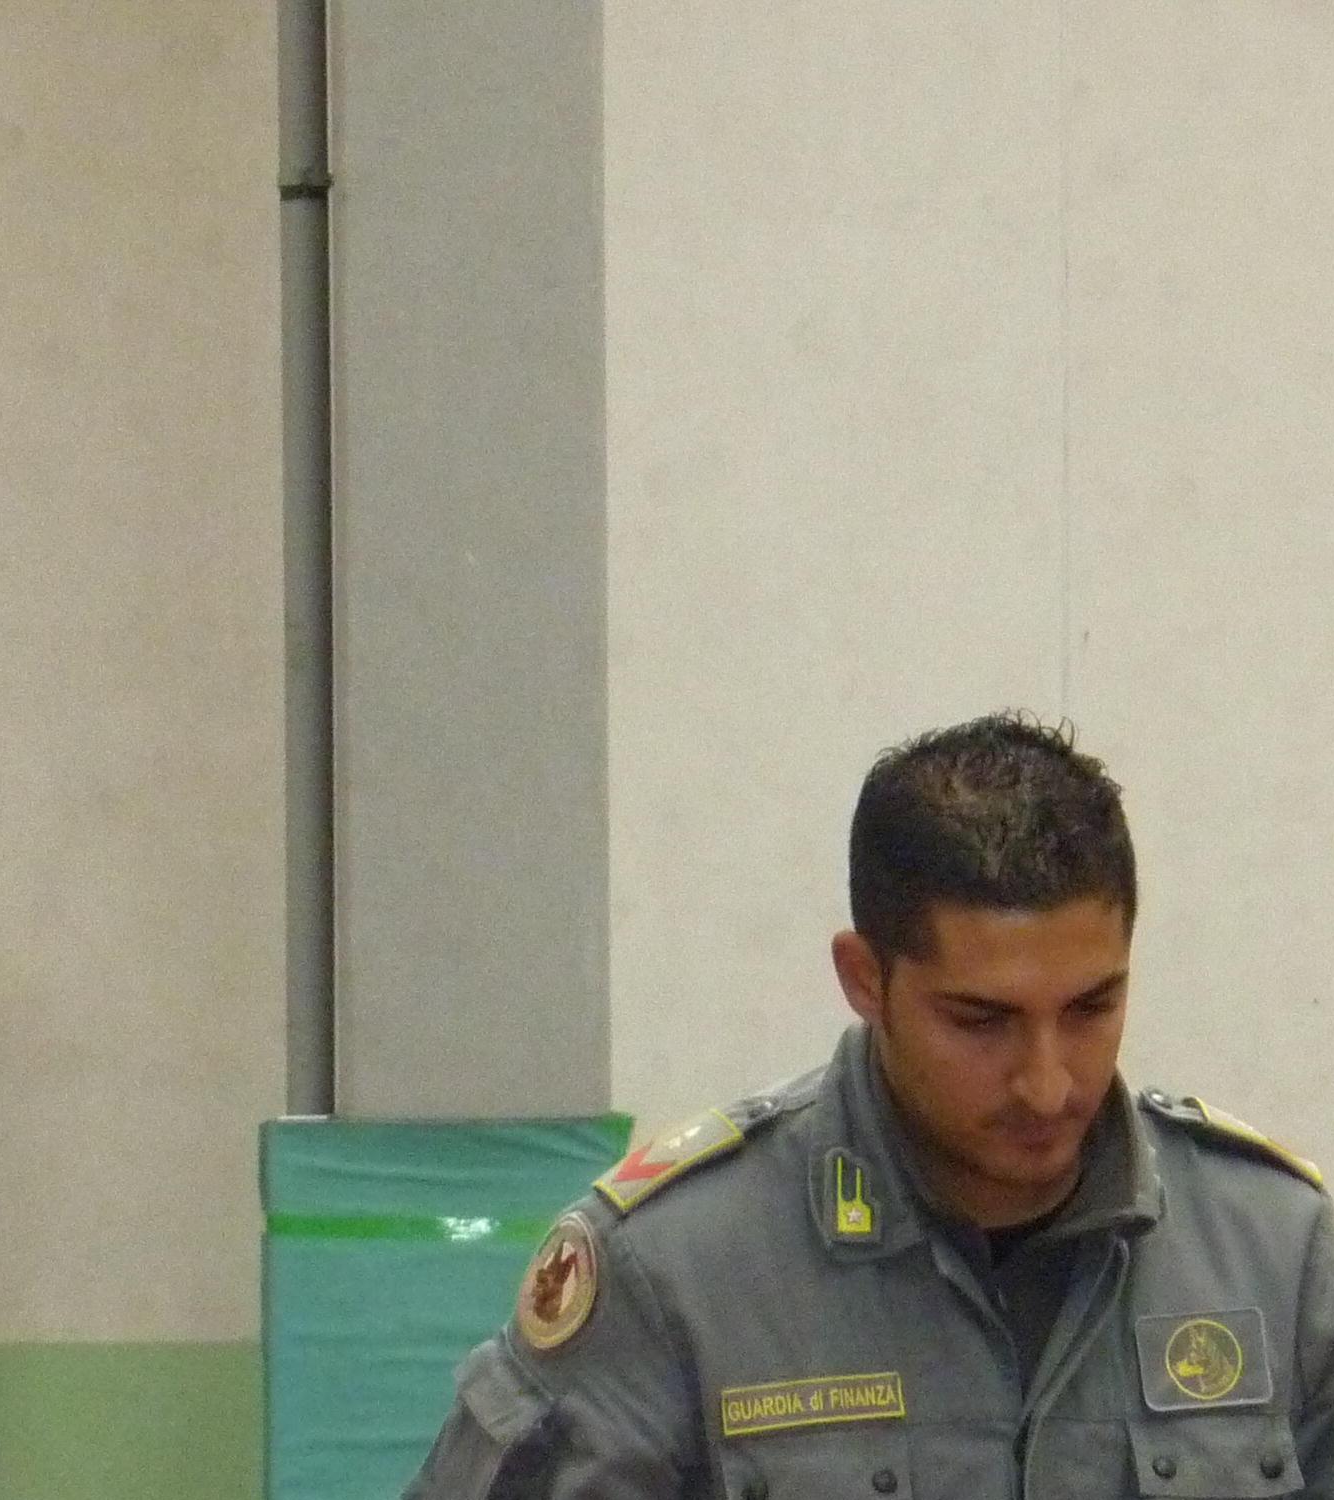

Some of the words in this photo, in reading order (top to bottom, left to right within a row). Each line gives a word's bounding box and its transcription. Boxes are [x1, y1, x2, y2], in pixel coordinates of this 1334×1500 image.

[728, 1393, 805, 1422] GUARDIA
[809, 1390, 824, 1411] di
[829, 1384, 897, 1409] FINANZA
